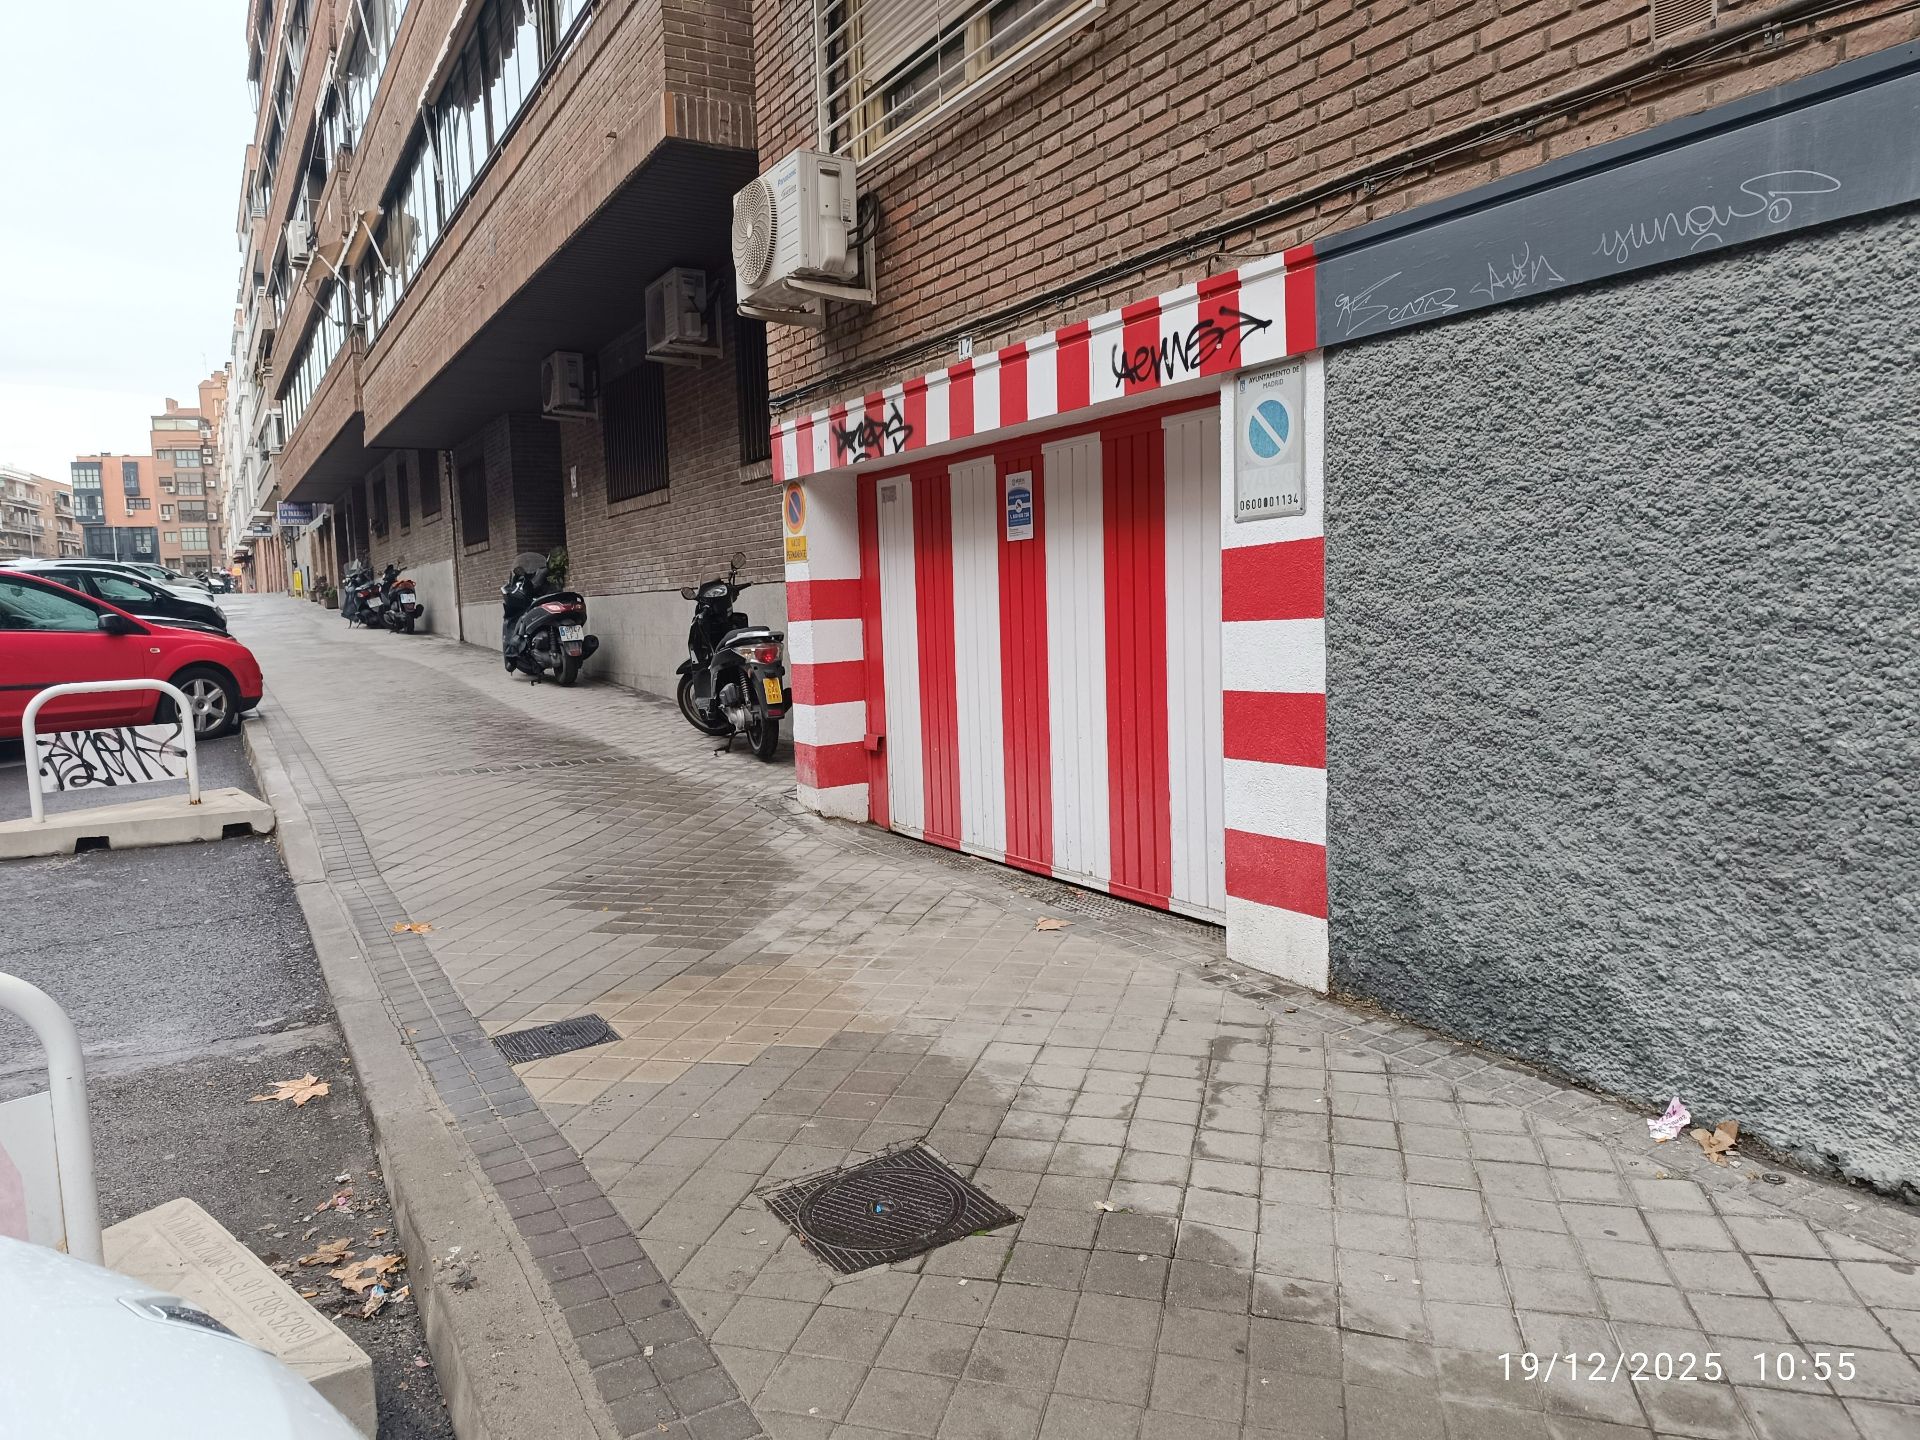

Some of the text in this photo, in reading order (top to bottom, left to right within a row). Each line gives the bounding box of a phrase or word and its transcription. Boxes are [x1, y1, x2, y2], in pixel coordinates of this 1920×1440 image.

[960, 338, 970, 356] 17
[1248, 366, 1300, 384] AYUNTAMIENTO DE
[1262, 379, 1284, 390] MADRID
